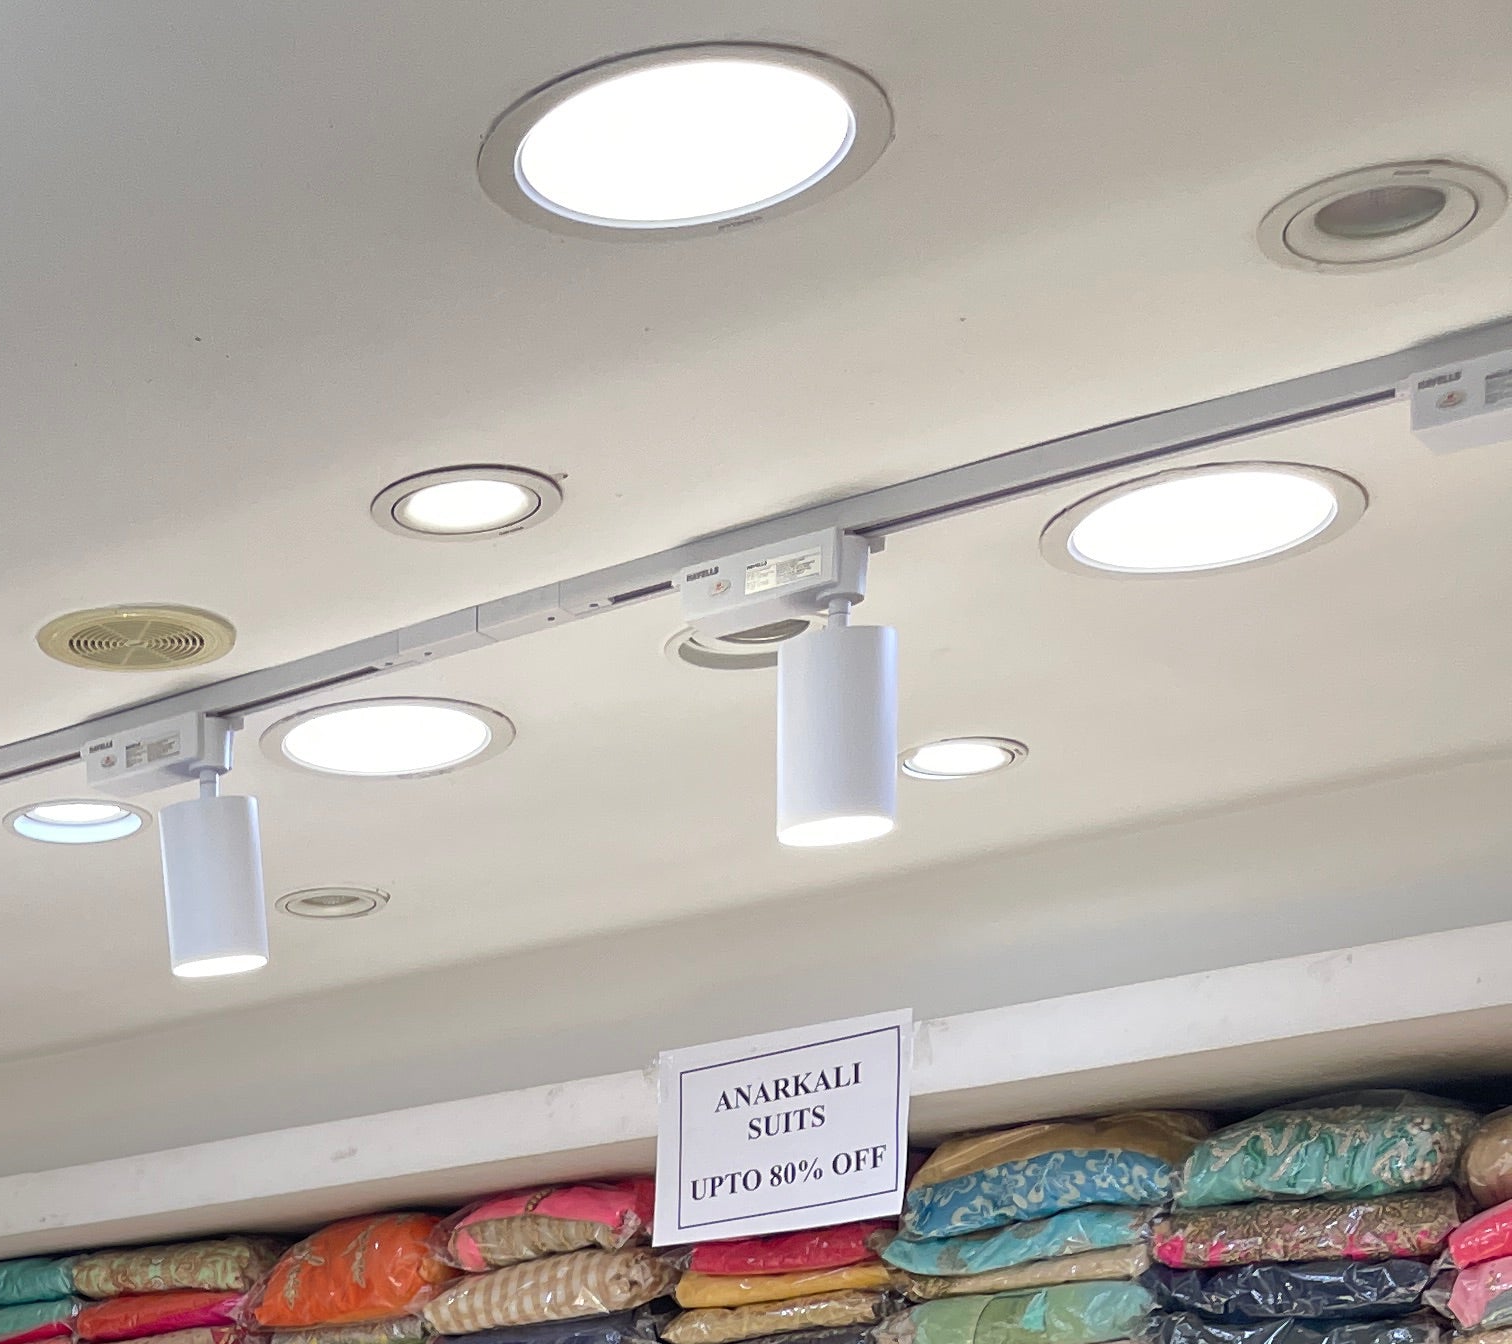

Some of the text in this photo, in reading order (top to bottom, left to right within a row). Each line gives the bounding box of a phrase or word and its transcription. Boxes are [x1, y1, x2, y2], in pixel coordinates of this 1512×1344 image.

[714, 1061, 862, 1113] ANARKALI
[747, 1104, 826, 1141] SUITS
[690, 1144, 888, 1201] UPTO 80% OFF
